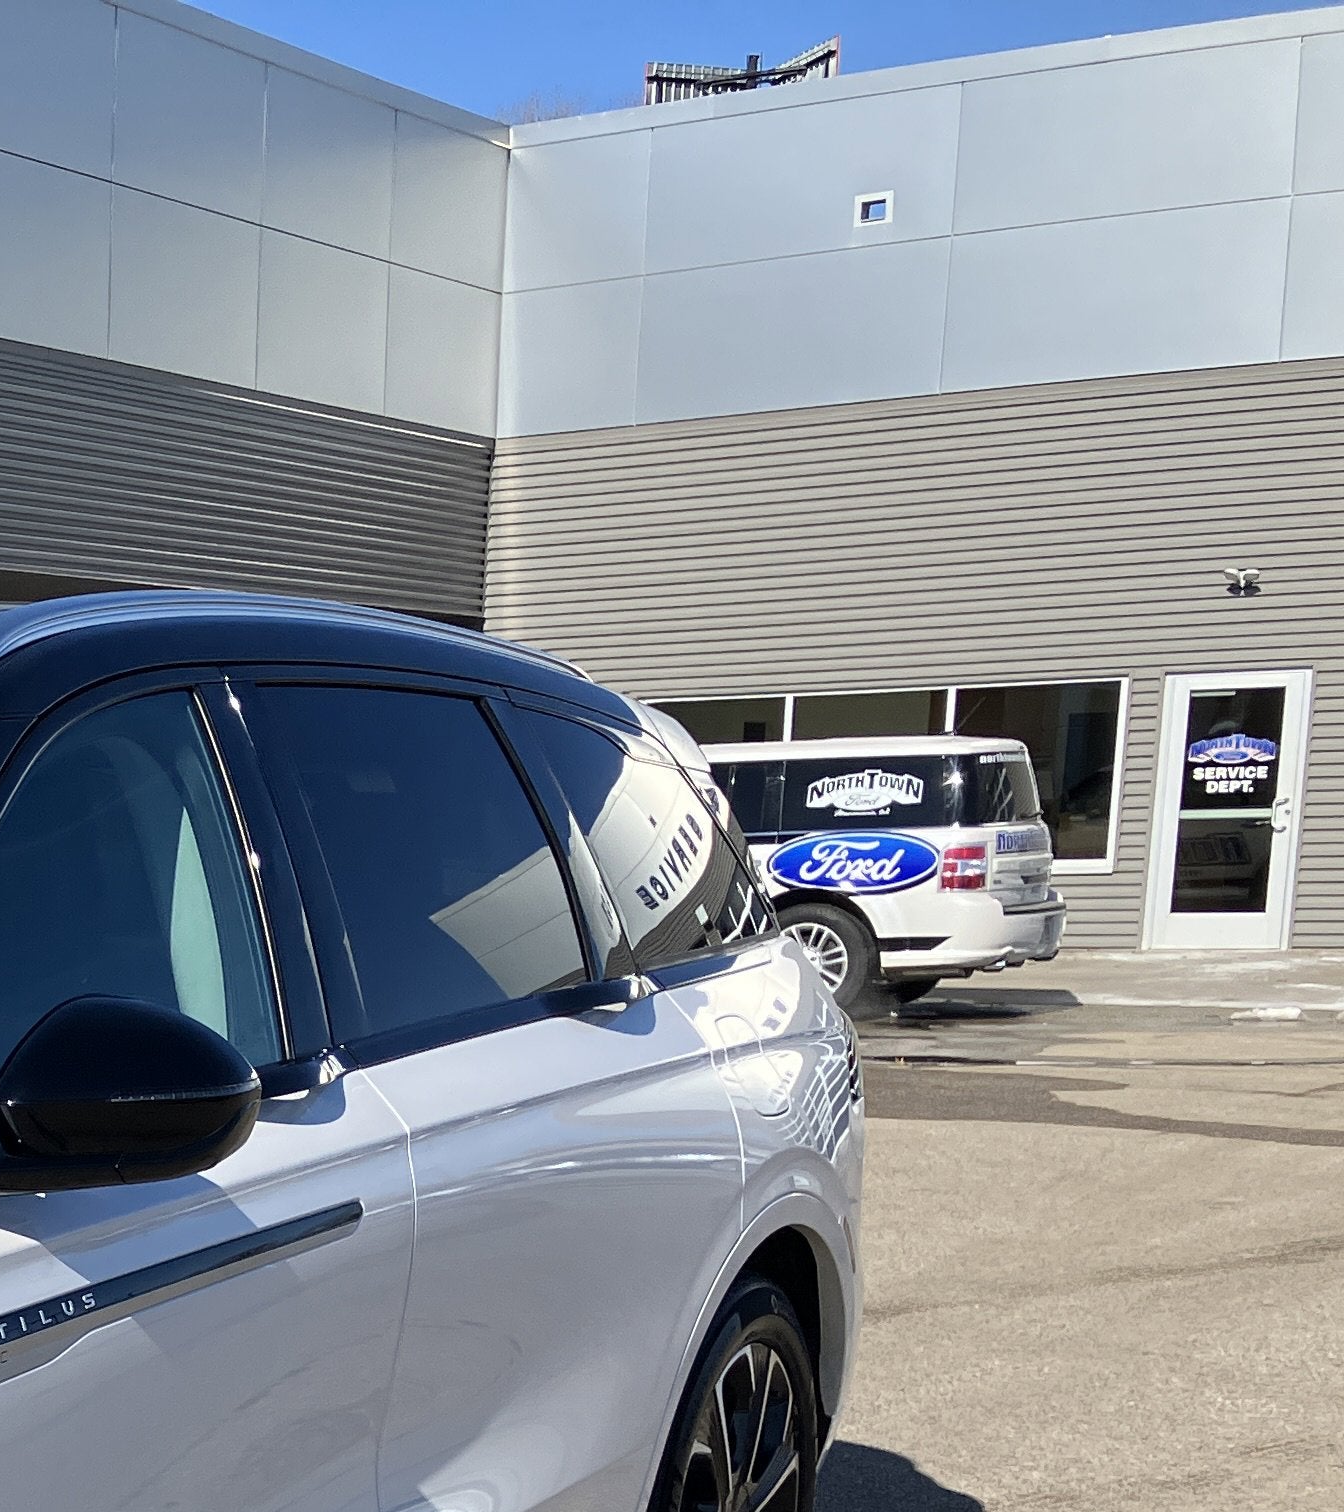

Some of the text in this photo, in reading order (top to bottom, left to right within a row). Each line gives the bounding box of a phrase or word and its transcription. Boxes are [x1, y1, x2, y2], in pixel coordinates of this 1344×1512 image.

[1192, 766, 1269, 780] SERVICE
[1205, 780, 1255, 794] DEPT.
[799, 839, 907, 881] Ford
